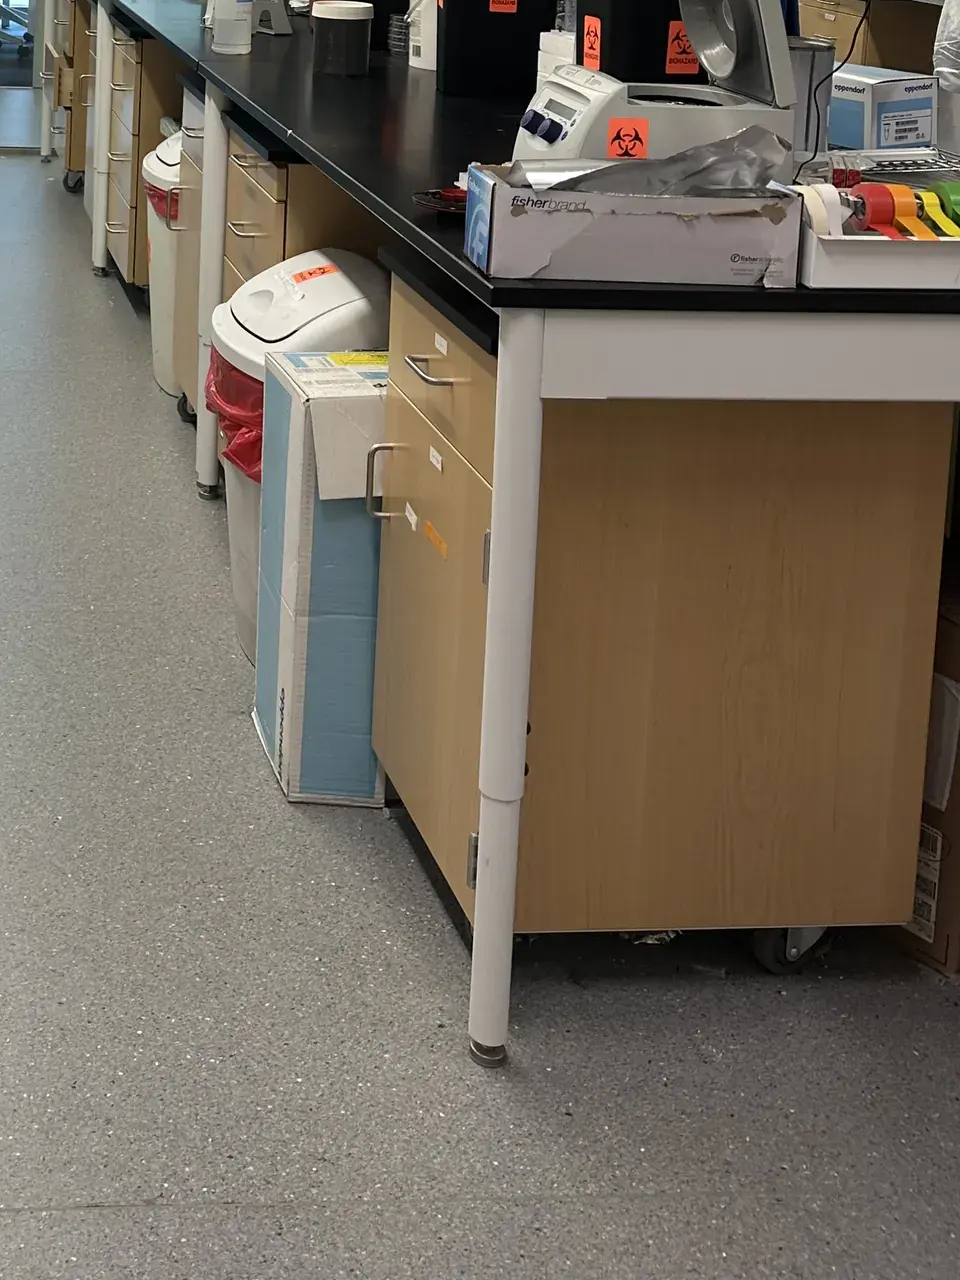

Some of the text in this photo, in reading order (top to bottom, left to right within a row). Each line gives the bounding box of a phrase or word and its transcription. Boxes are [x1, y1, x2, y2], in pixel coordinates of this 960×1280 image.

[668, 57, 699, 65] BIOHAZARD
[834, 83, 865, 94] eppendorf
[904, 82, 933, 93] eppendorf
[511, 195, 586, 211] fisherbrand
